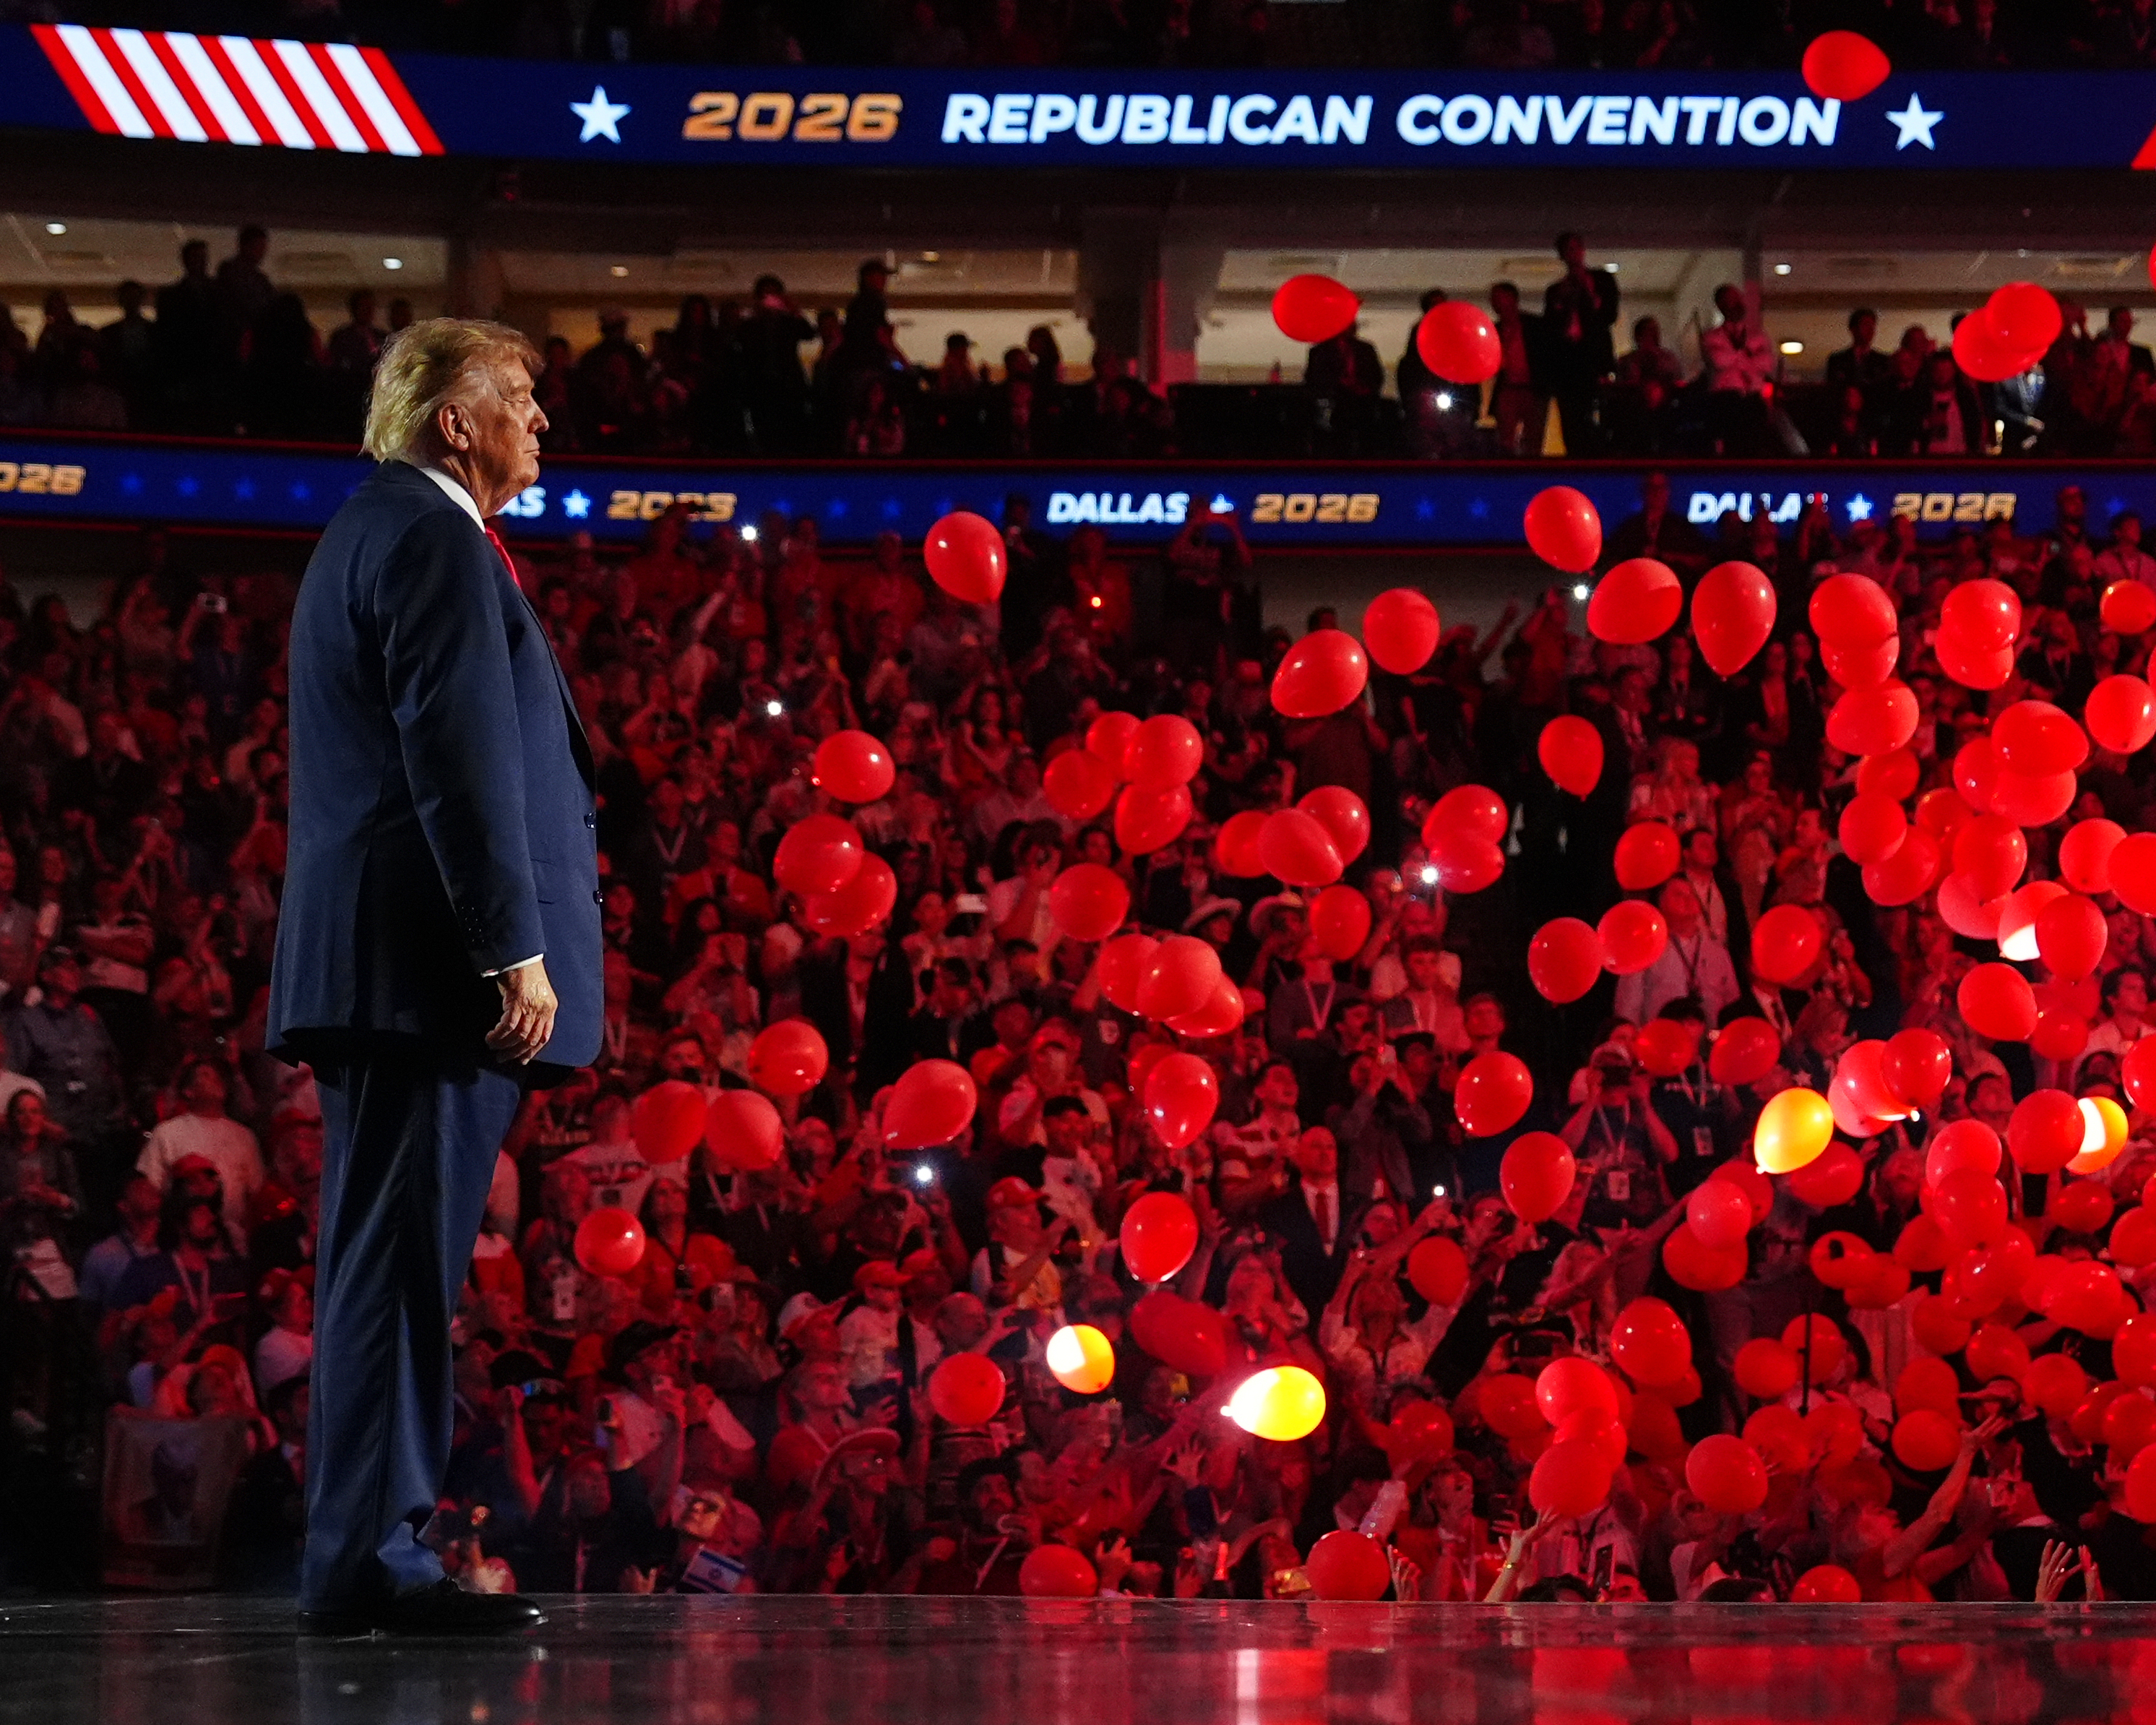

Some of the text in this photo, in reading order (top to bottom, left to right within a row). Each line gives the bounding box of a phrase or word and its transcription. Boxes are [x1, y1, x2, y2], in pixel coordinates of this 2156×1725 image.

[683, 92, 1841, 146] 2026 REPUBLICAN CONVENTION
[1047, 493, 1379, 523] DALLAS 2026
